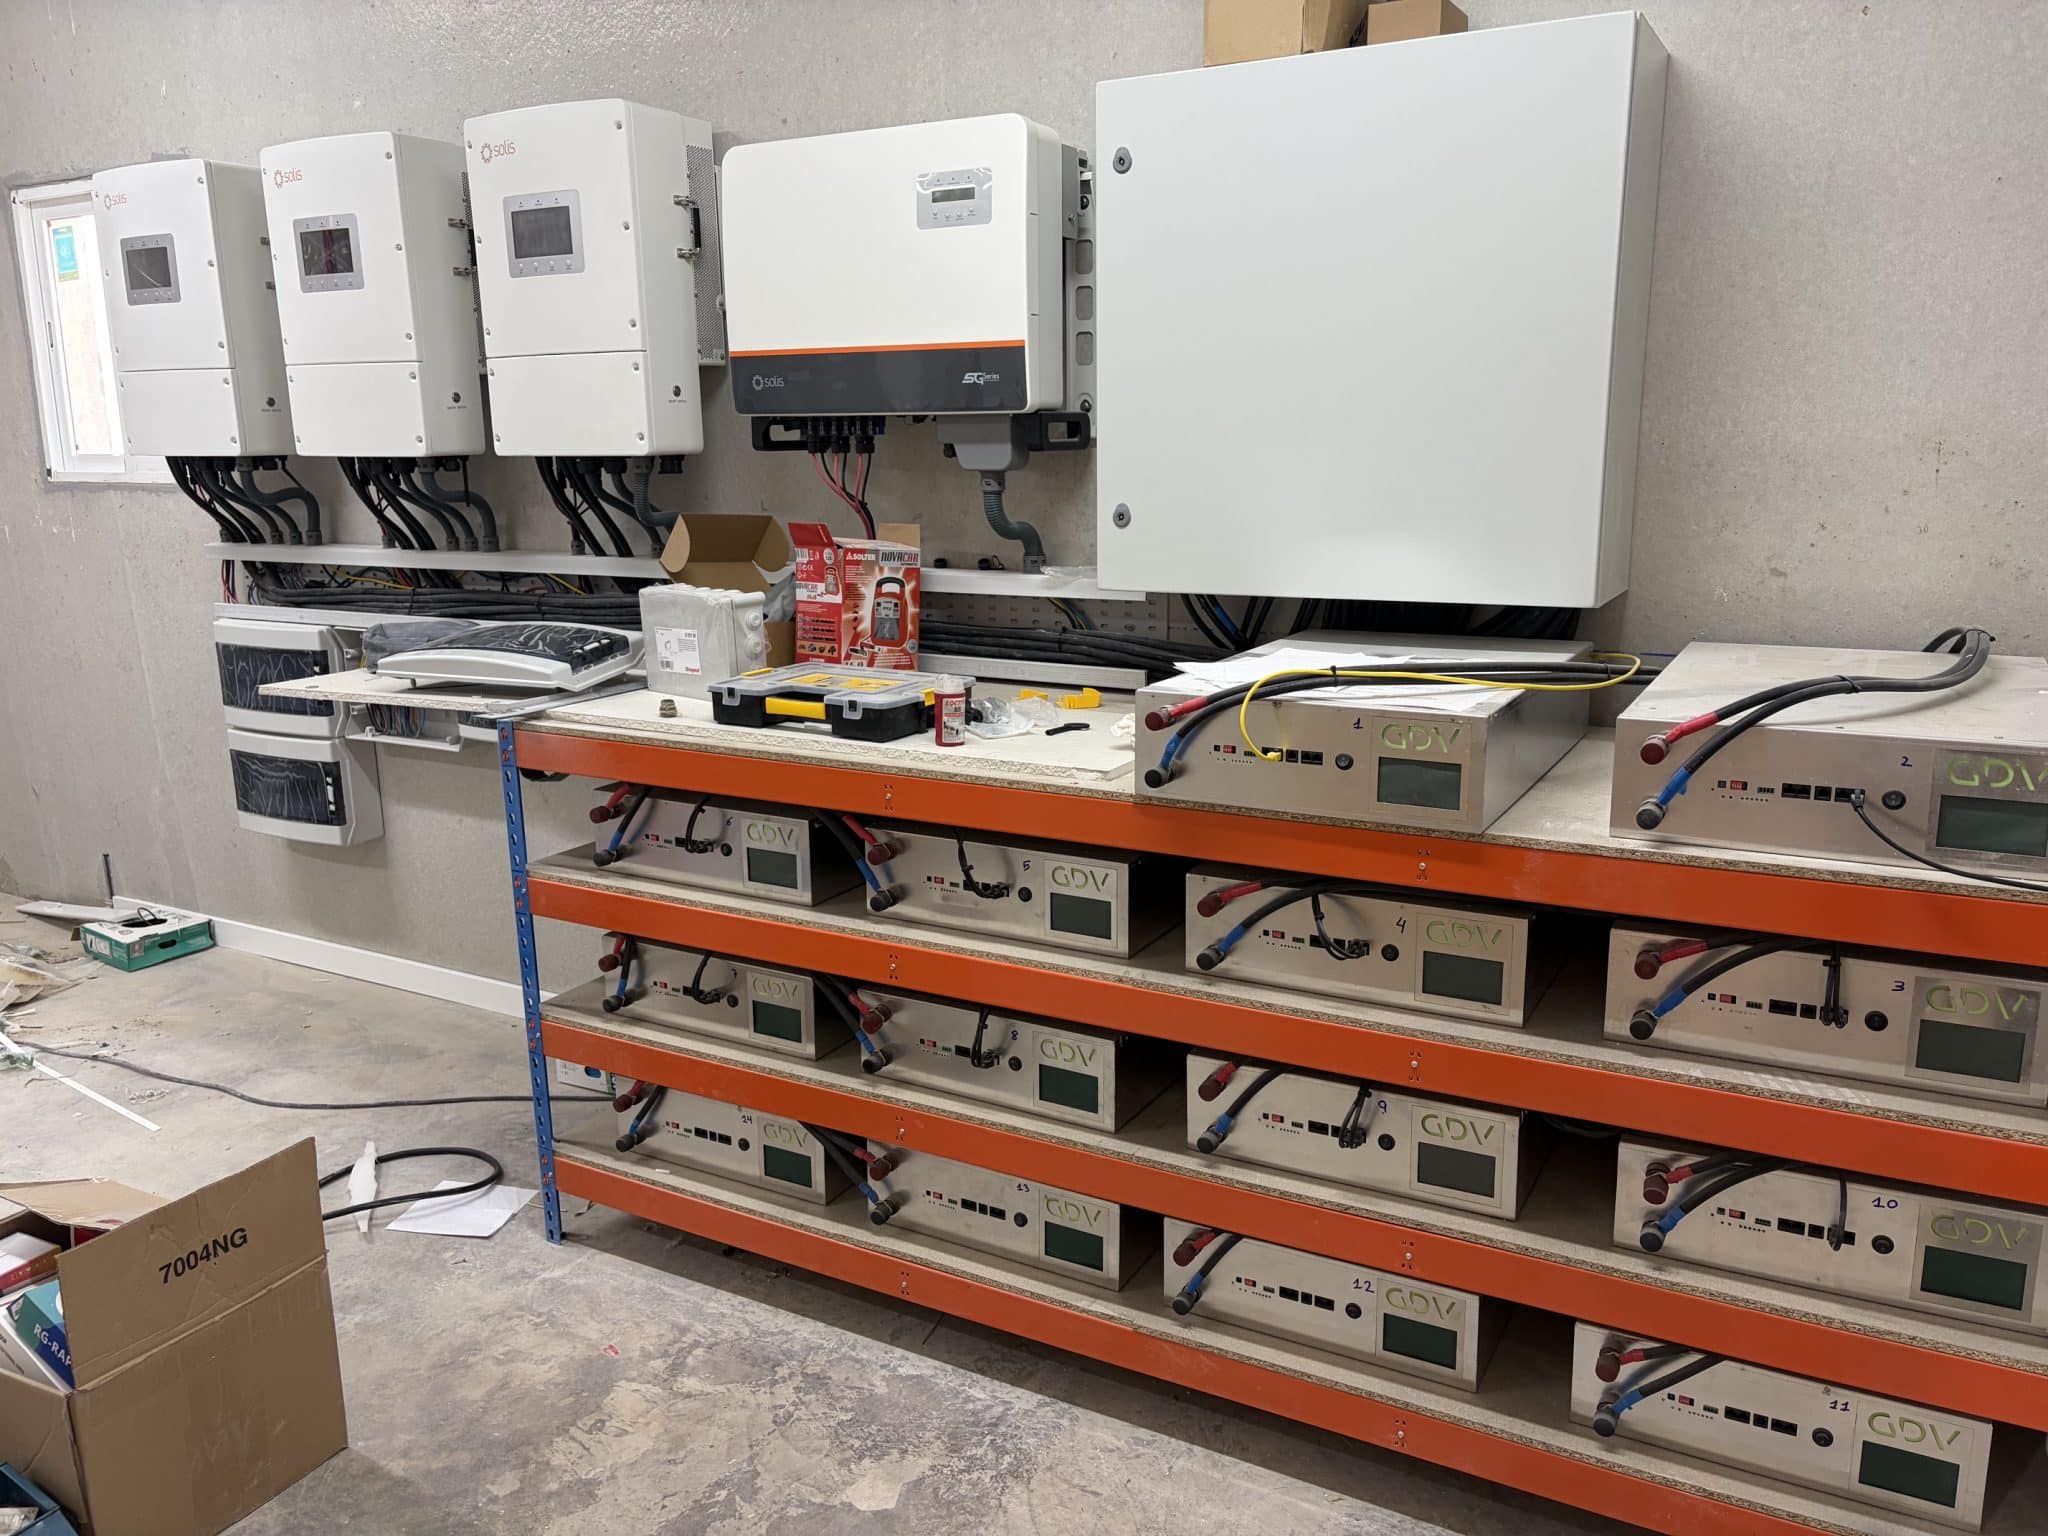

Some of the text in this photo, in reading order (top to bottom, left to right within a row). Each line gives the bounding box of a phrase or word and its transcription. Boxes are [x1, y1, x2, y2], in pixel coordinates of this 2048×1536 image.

[493, 139, 516, 157] solis
[284, 168, 302, 183] solis
[764, 375, 785, 388] solis
[881, 551, 919, 563] NOVACAR
[1353, 717, 1364, 730] 1
[1381, 723, 1461, 753] GDV
[1900, 755, 1912, 767] 2
[1946, 755, 2048, 792] GDV
[746, 823, 794, 847] GDV
[1022, 860, 1031, 871] 5
[1051, 865, 1110, 892] GDV
[1396, 916, 1407, 934] 4
[1426, 920, 1503, 951] GDV
[752, 977, 799, 1001] GDV
[1891, 980, 1905, 992] 3
[1926, 984, 2028, 1021] GDV
[1011, 1030, 1019, 1041] 8
[1040, 1038, 1097, 1067] GDV
[1378, 1100, 1387, 1115] 9
[764, 1122, 809, 1148] GDV
[1421, 1113, 1495, 1146] GDV
[1016, 1183, 1030, 1193] 13
[1046, 1197, 1102, 1228] GDV
[1871, 1197, 1898, 1209] 10
[1930, 1214, 2031, 1250] GDV
[158, 1227, 249, 1285] 7004NG
[1353, 1278, 1375, 1293] 12
[1386, 1287, 1457, 1320] GDV
[1829, 1400, 1850, 1412] 11
[1867, 1411, 1961, 1452] GDV
